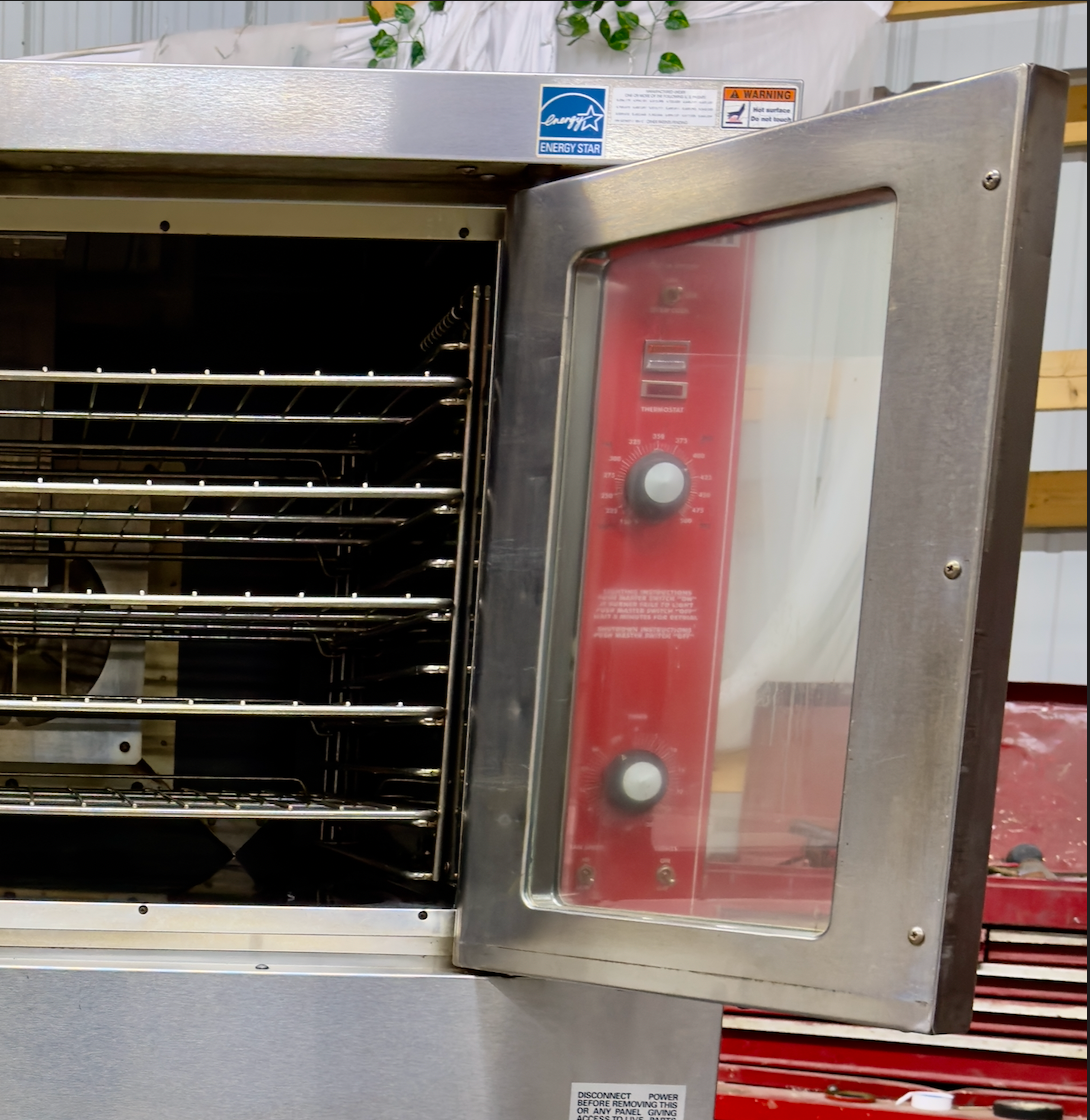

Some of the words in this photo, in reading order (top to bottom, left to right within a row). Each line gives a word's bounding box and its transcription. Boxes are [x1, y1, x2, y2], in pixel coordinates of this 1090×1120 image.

[744, 90, 791, 99] WARNING
[540, 142, 576, 153] ENERGY
[577, 143, 600, 153] STAR
[578, 1092, 631, 1100] DISCONNECT
[649, 1093, 678, 1101] POWER
[615, 1108, 641, 1116] PANEL
